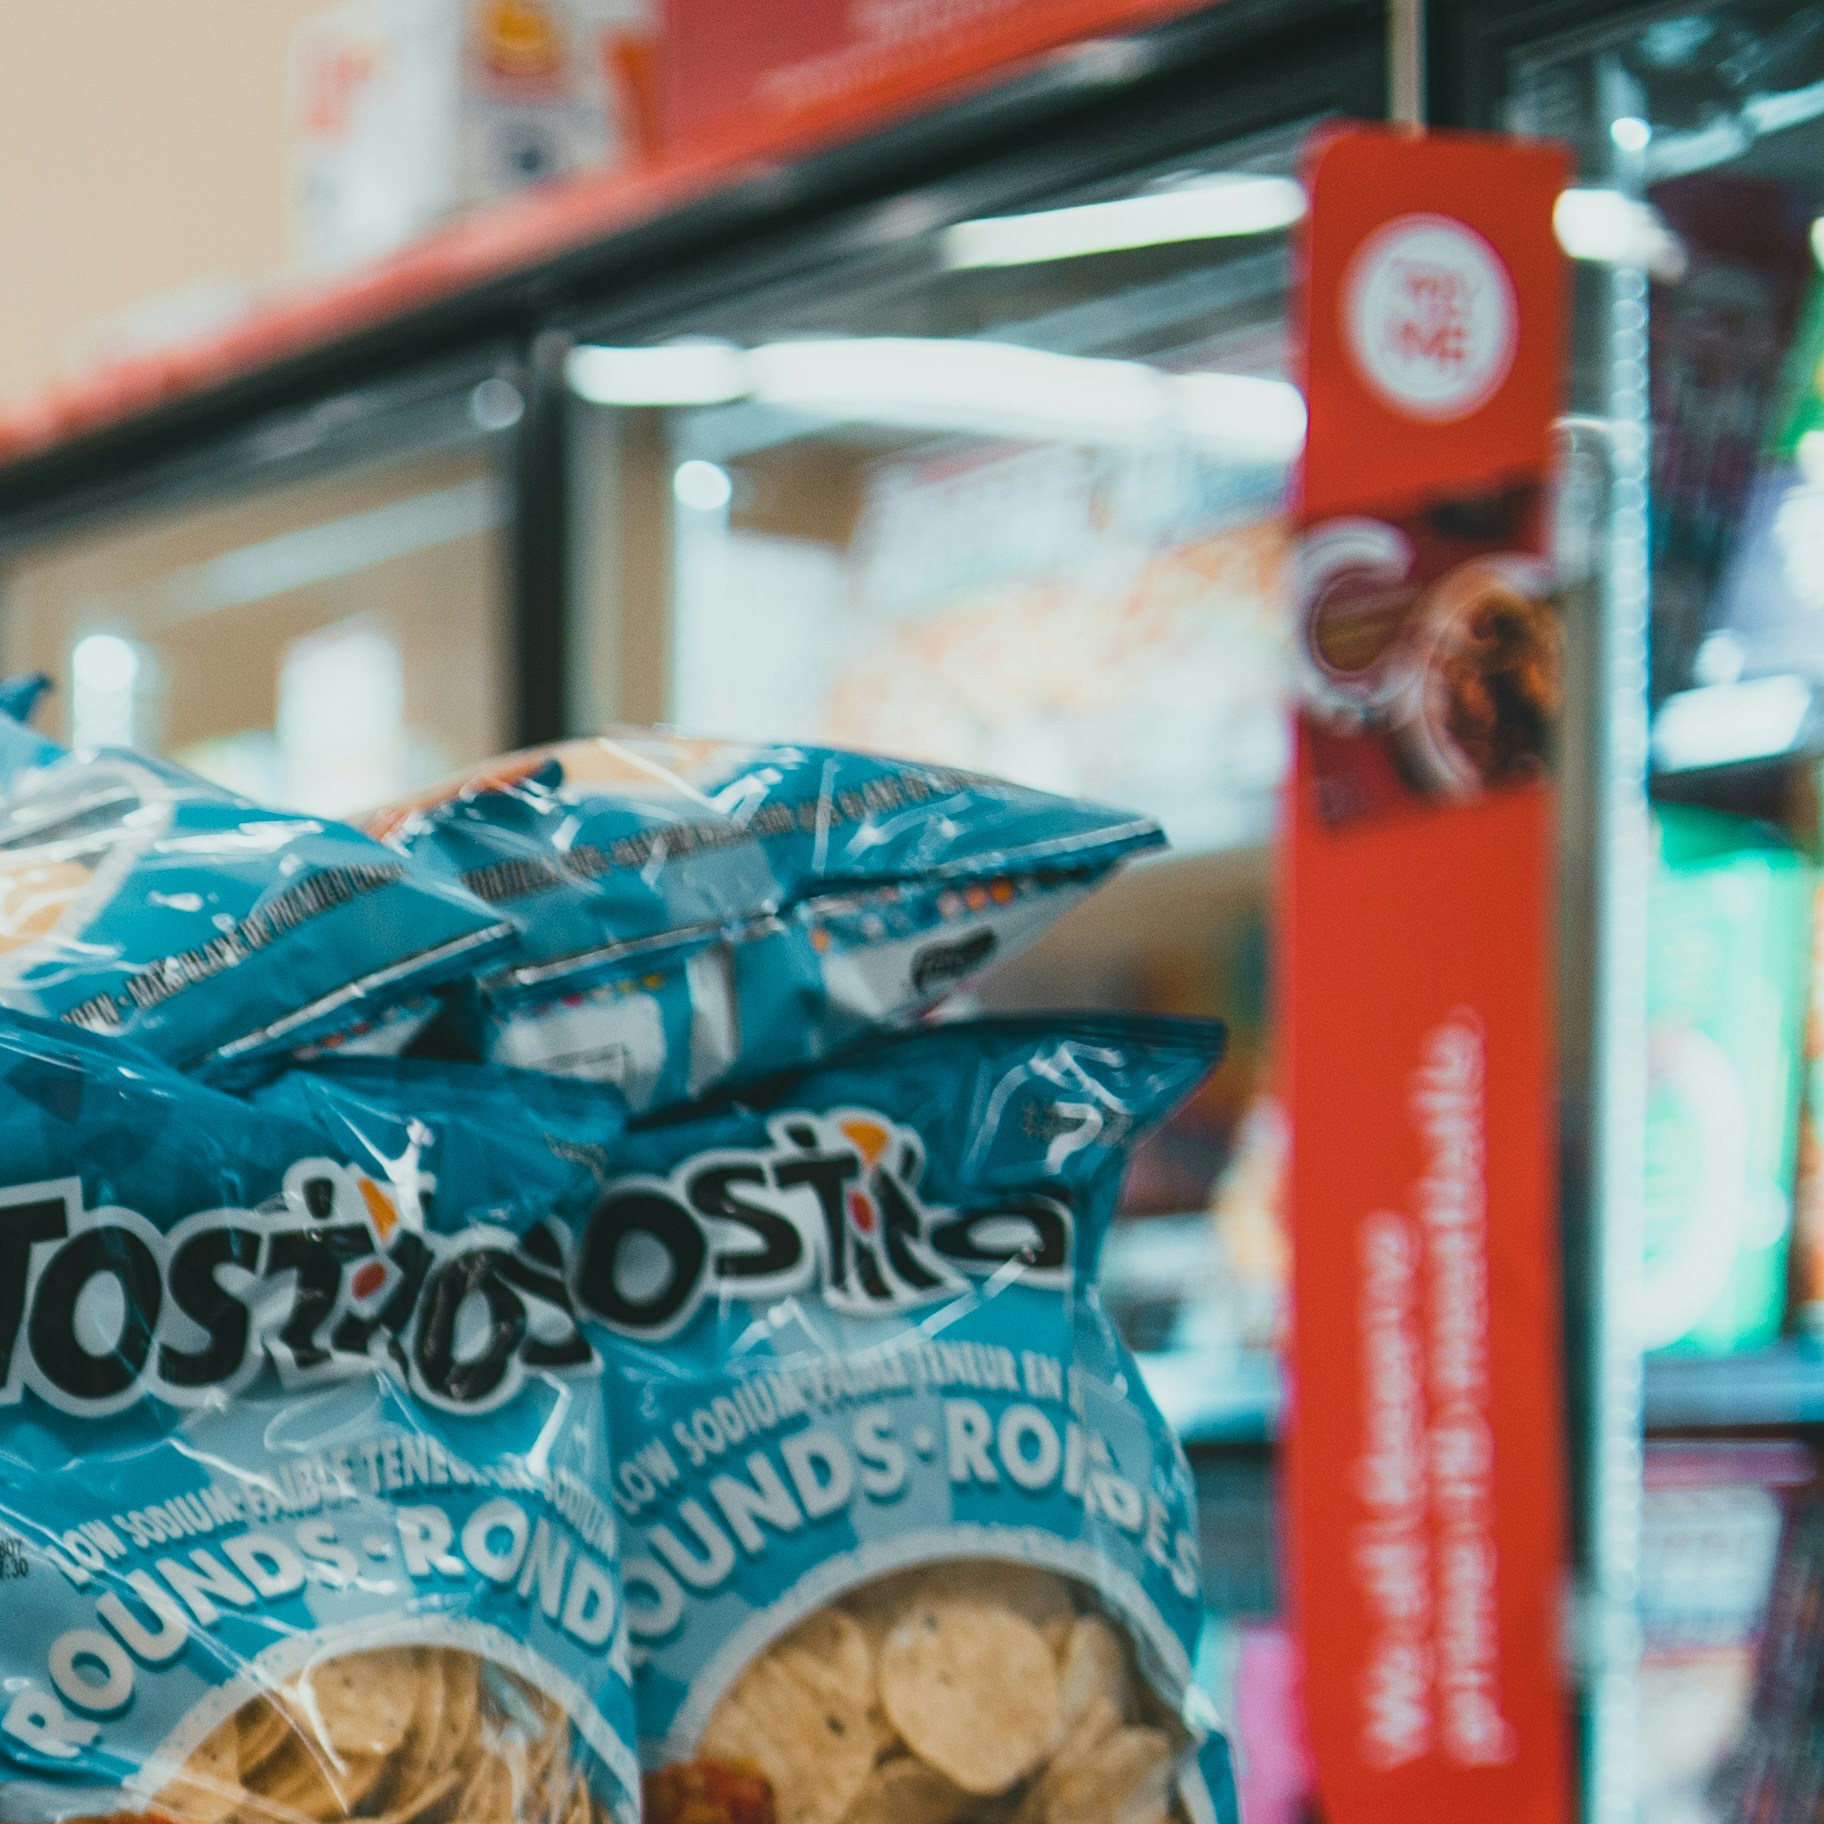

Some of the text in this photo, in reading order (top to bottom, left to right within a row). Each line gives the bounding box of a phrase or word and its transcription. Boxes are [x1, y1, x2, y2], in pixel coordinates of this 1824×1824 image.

[673, 1372, 798, 1466] SODIUM
[50, 1521, 127, 1585] LOW
[119, 1475, 236, 1541] SODIUM
[620, 1407, 907, 1637] OUNDS
[1, 1500, 616, 1759] ROUNDS ROND
